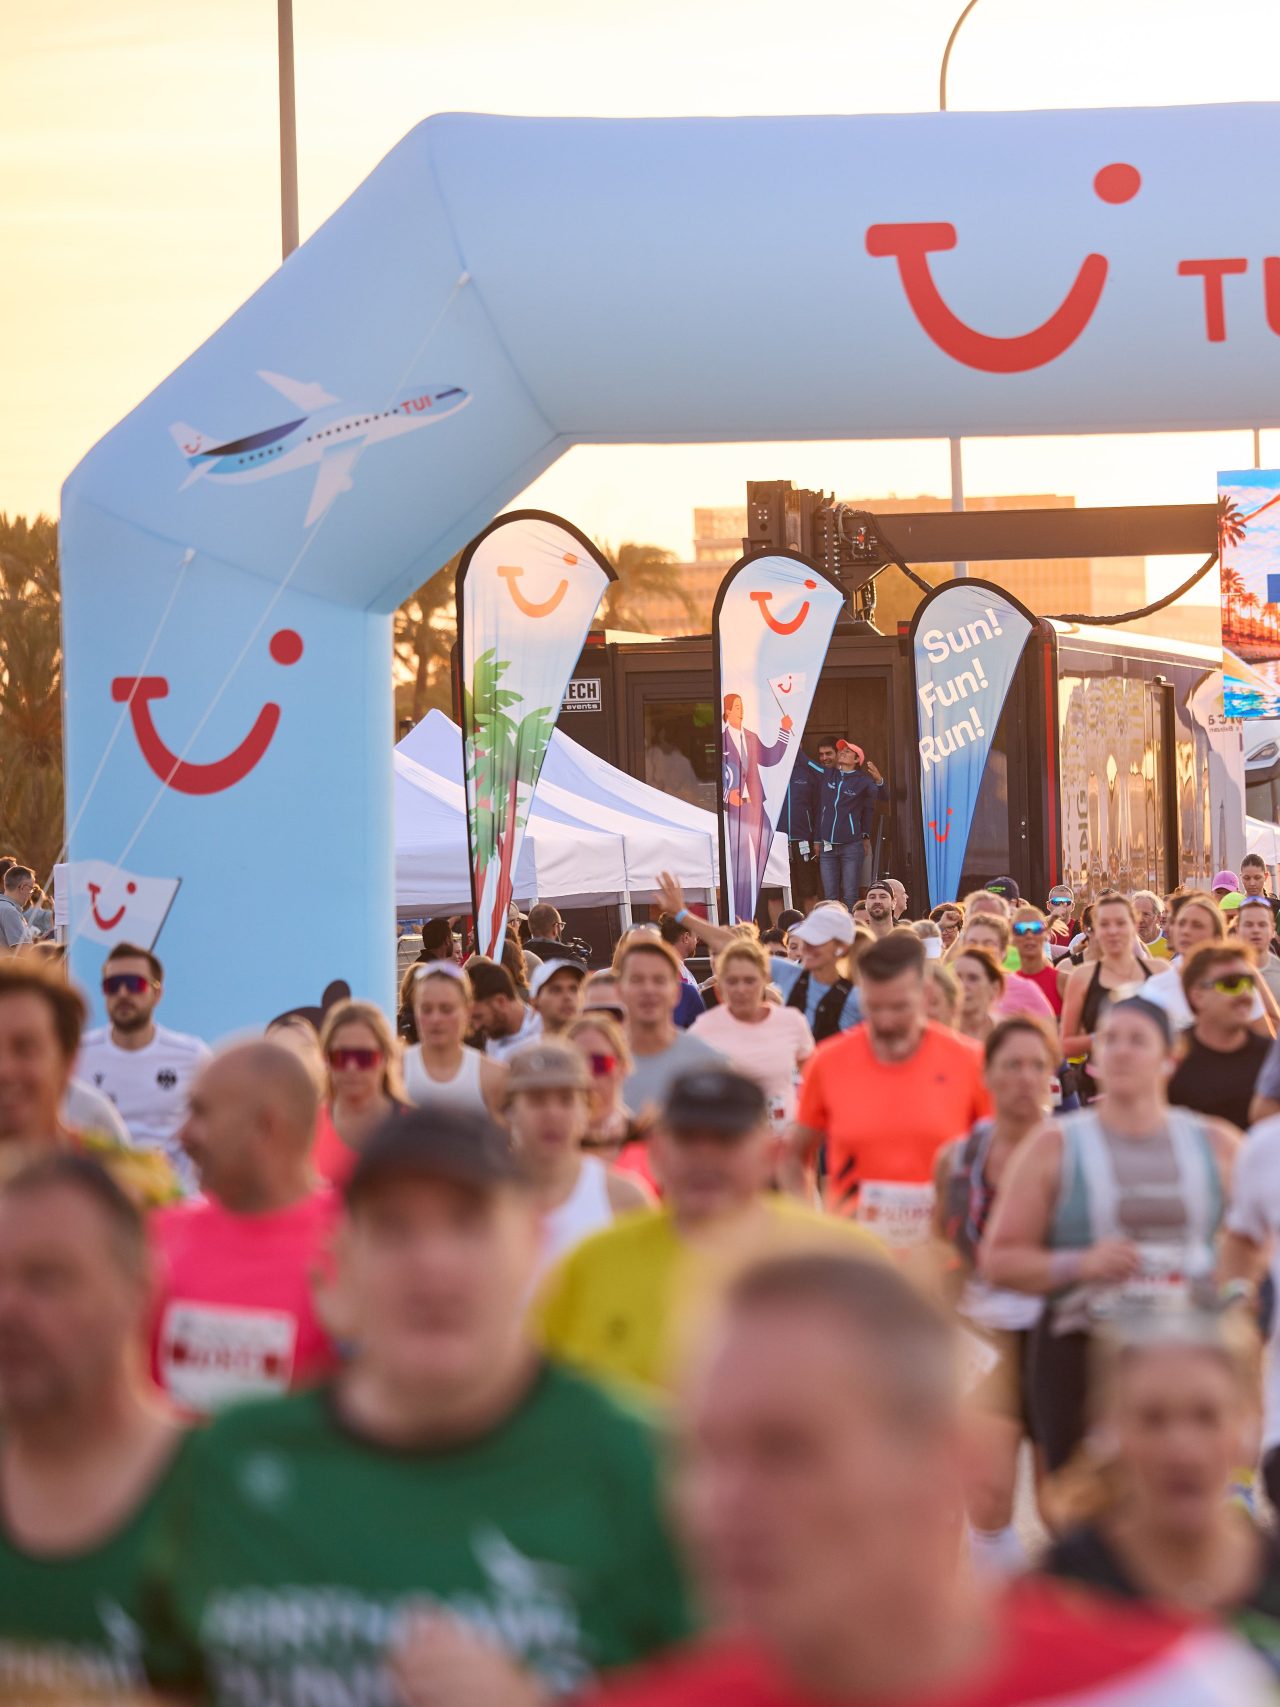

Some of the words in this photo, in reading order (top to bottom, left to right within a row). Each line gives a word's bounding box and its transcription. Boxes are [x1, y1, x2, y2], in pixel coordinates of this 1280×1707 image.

[400, 395, 433, 415] TUI
[922, 608, 1003, 664] Sun!
[565, 682, 597, 699] ECH
[918, 657, 989, 718] Fun!
[918, 706, 985, 773] Run!
